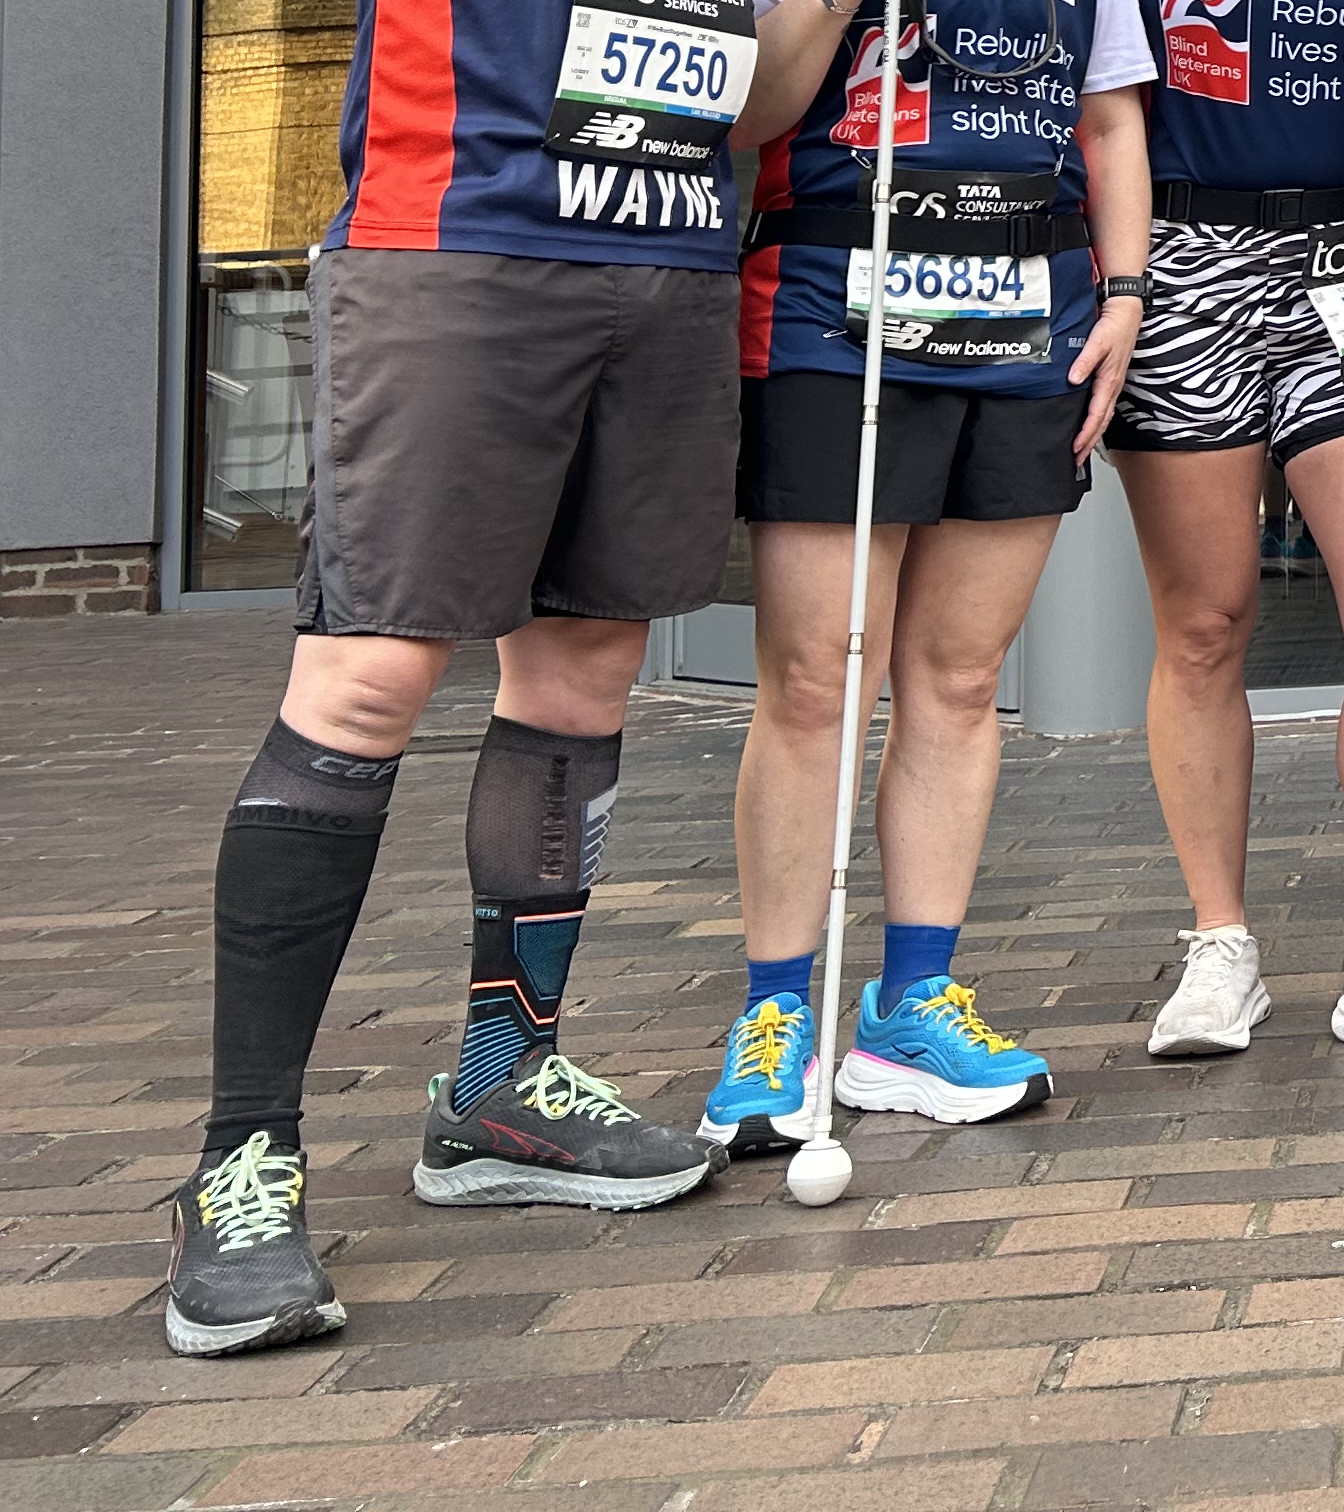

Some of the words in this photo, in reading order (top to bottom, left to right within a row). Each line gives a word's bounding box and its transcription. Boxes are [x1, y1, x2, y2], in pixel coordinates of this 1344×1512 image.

[1169, 35, 1207, 56] Blind
[1271, 32, 1337, 63] lives
[601, 32, 727, 100] 57250
[1170, 52, 1242, 79] Veterans
[1174, 74, 1191, 87] UK
[1268, 72, 1342, 106] sight
[837, 126, 860, 141] UK
[952, 104, 1030, 139] sight
[1035, 109, 1074, 145] loss
[642, 139, 670, 154] new
[670, 140, 710, 159] balance
[559, 160, 723, 229] WAYNE
[958, 185, 1001, 198] TATA
[884, 253, 1024, 301] 56854
[926, 341, 962, 354] new
[964, 341, 1031, 356] balance
